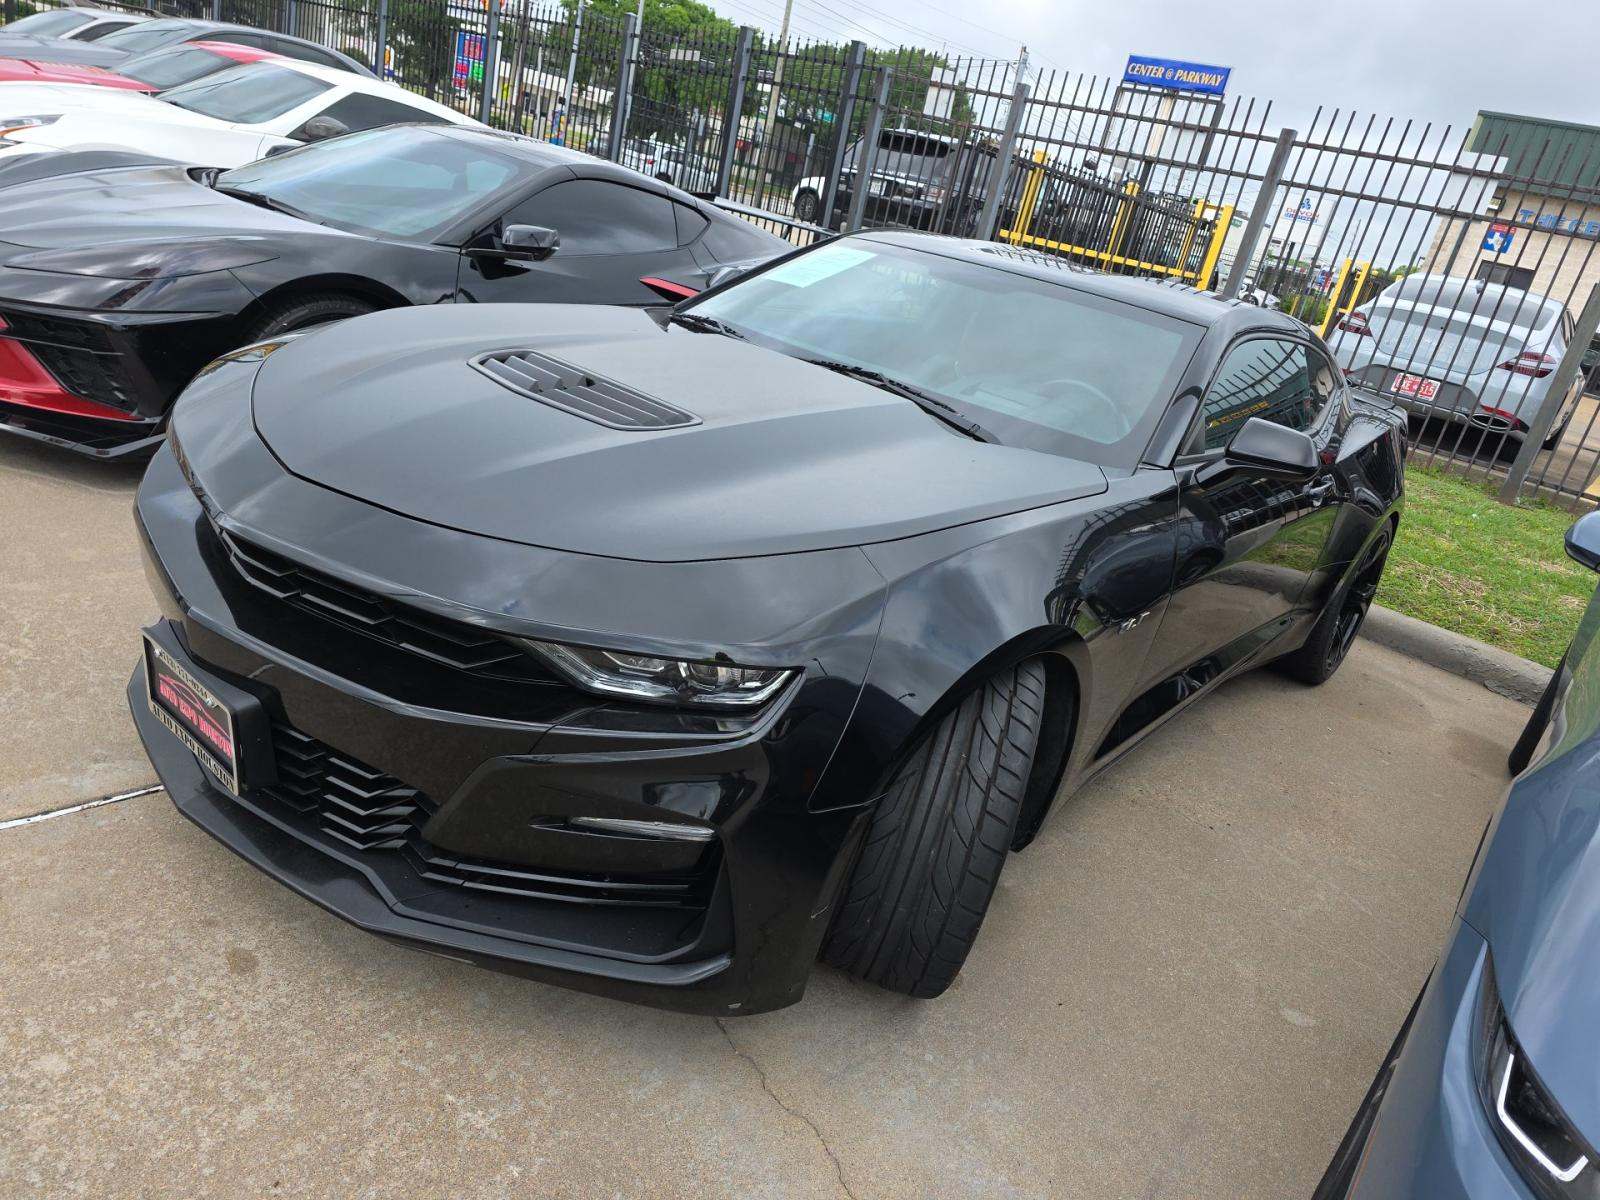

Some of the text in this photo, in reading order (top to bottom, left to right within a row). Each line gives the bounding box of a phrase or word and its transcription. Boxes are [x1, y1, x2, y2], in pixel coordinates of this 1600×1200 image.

[1127, 62, 1224, 86] CENTER @ PARKWAY
[152, 703, 235, 793] AUTO EXPO HOUSTON
